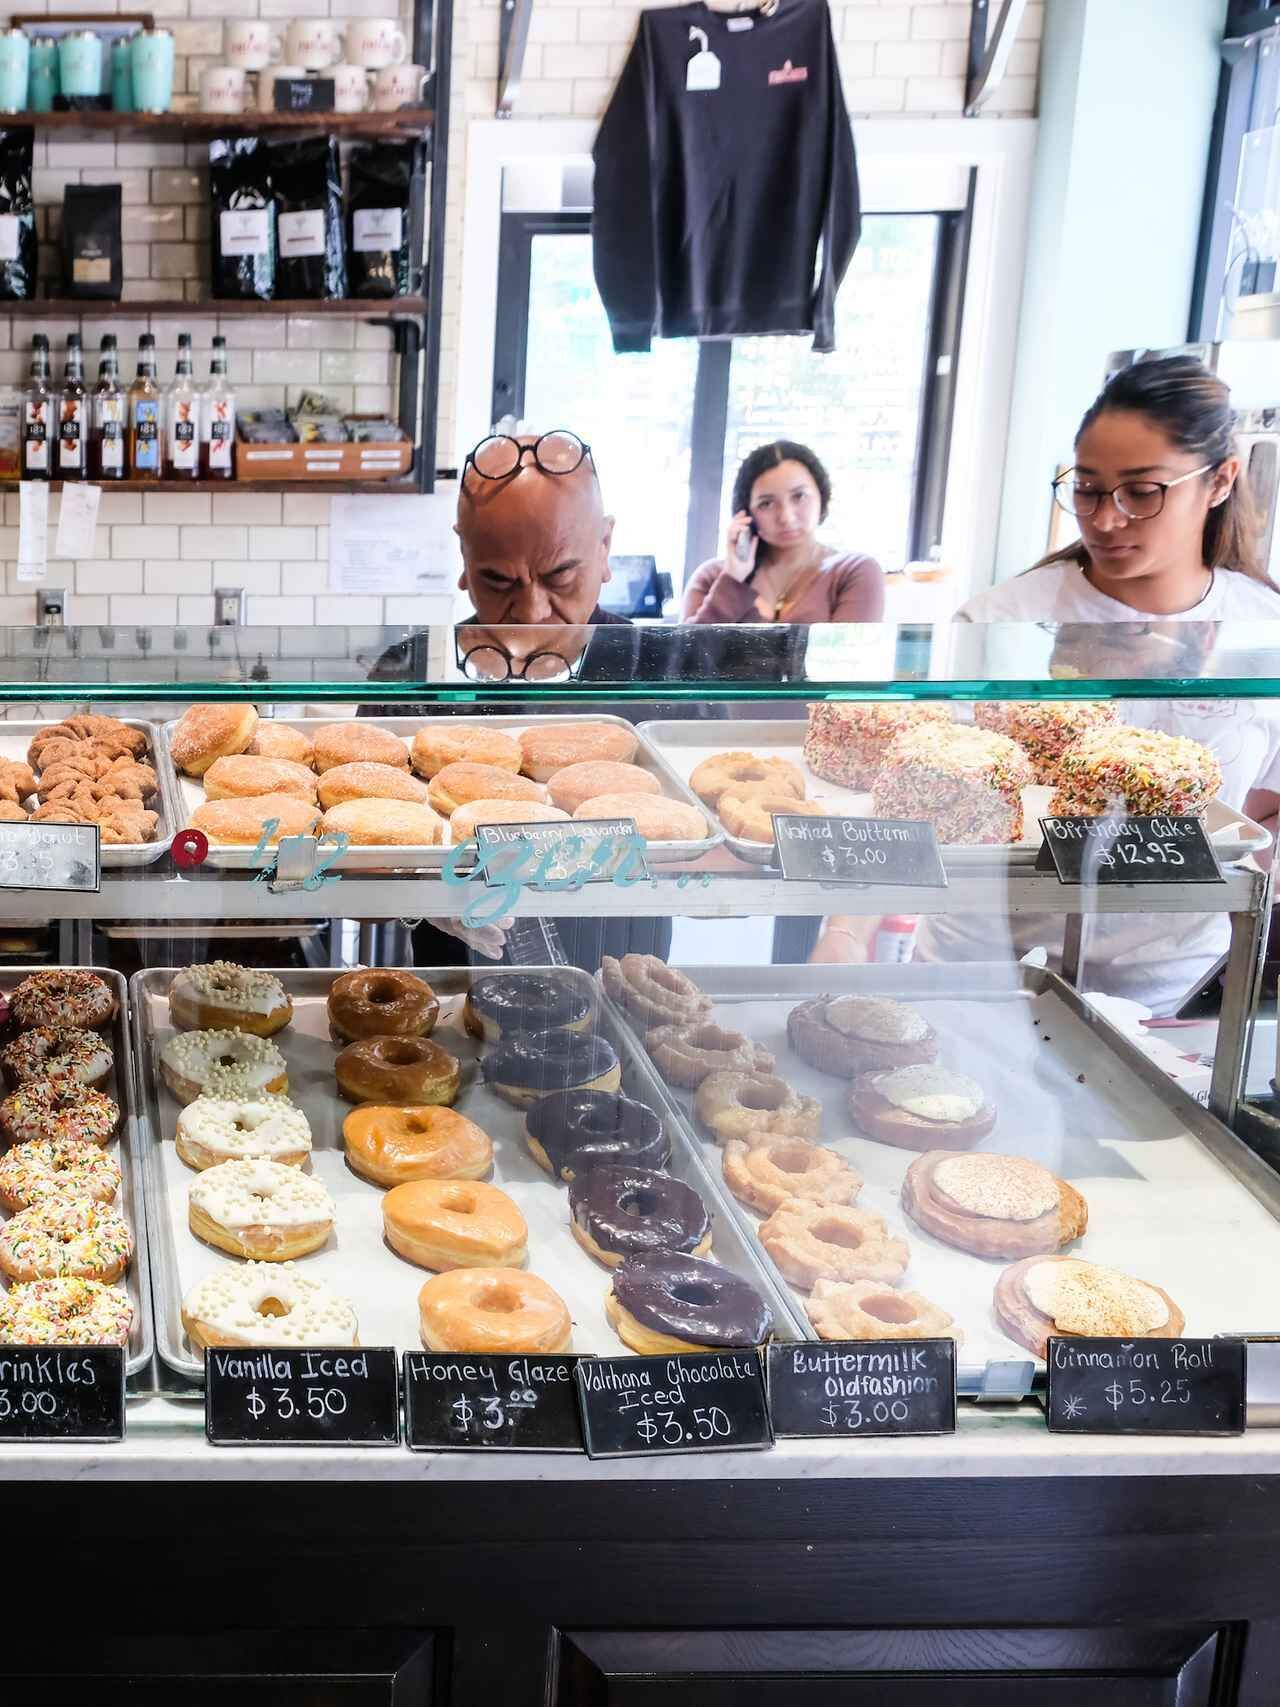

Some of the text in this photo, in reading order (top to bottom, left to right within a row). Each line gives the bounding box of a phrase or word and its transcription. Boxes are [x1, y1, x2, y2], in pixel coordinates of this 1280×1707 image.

[1052, 819, 1197, 843] Birthday Cake
[822, 845, 887, 871] $3.00
[1094, 843, 1185, 869] $12.95
[215, 1352, 369, 1380] Vanilla Iced
[793, 1348, 928, 1375] Buttermilk
[1055, 1343, 1217, 1370] Cinnamon Roll
[410, 1356, 579, 1392] Honey Glaze
[579, 1355, 756, 1392] Valrhona Chocolate
[246, 1386, 348, 1420] $3.50
[619, 1385, 686, 1410] Iced
[1104, 1379, 1191, 1411] $5.25
[636, 1406, 731, 1445] $3.50
[819, 1400, 909, 1428] $3.00
